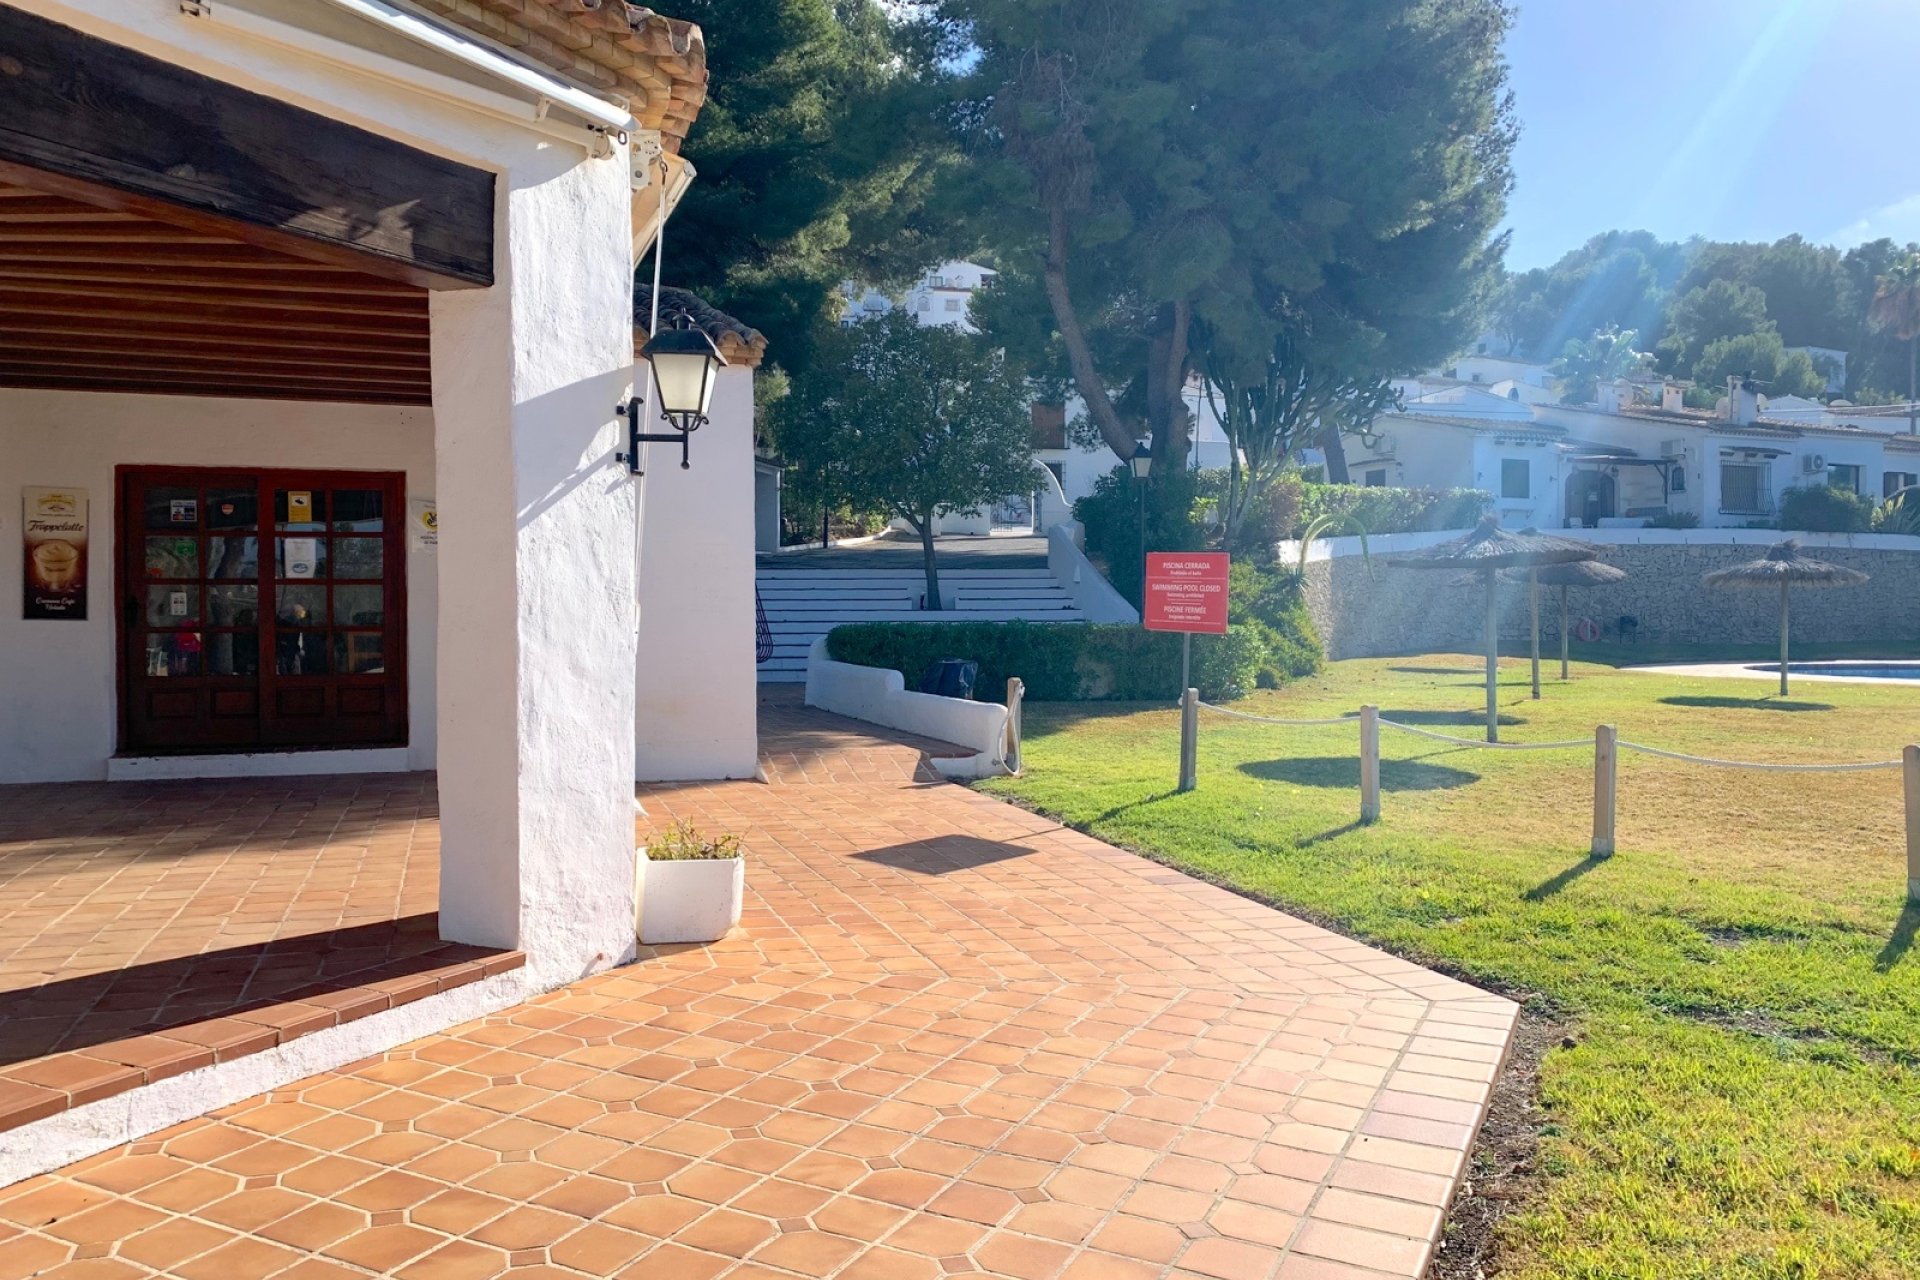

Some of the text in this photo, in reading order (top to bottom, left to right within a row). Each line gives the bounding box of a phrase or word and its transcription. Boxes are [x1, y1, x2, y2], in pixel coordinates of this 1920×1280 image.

[1183, 584, 1199, 592] POOL
[1199, 584, 1221, 593] CLOSED
[1163, 605, 1207, 614] PISCINE FERMÉE
